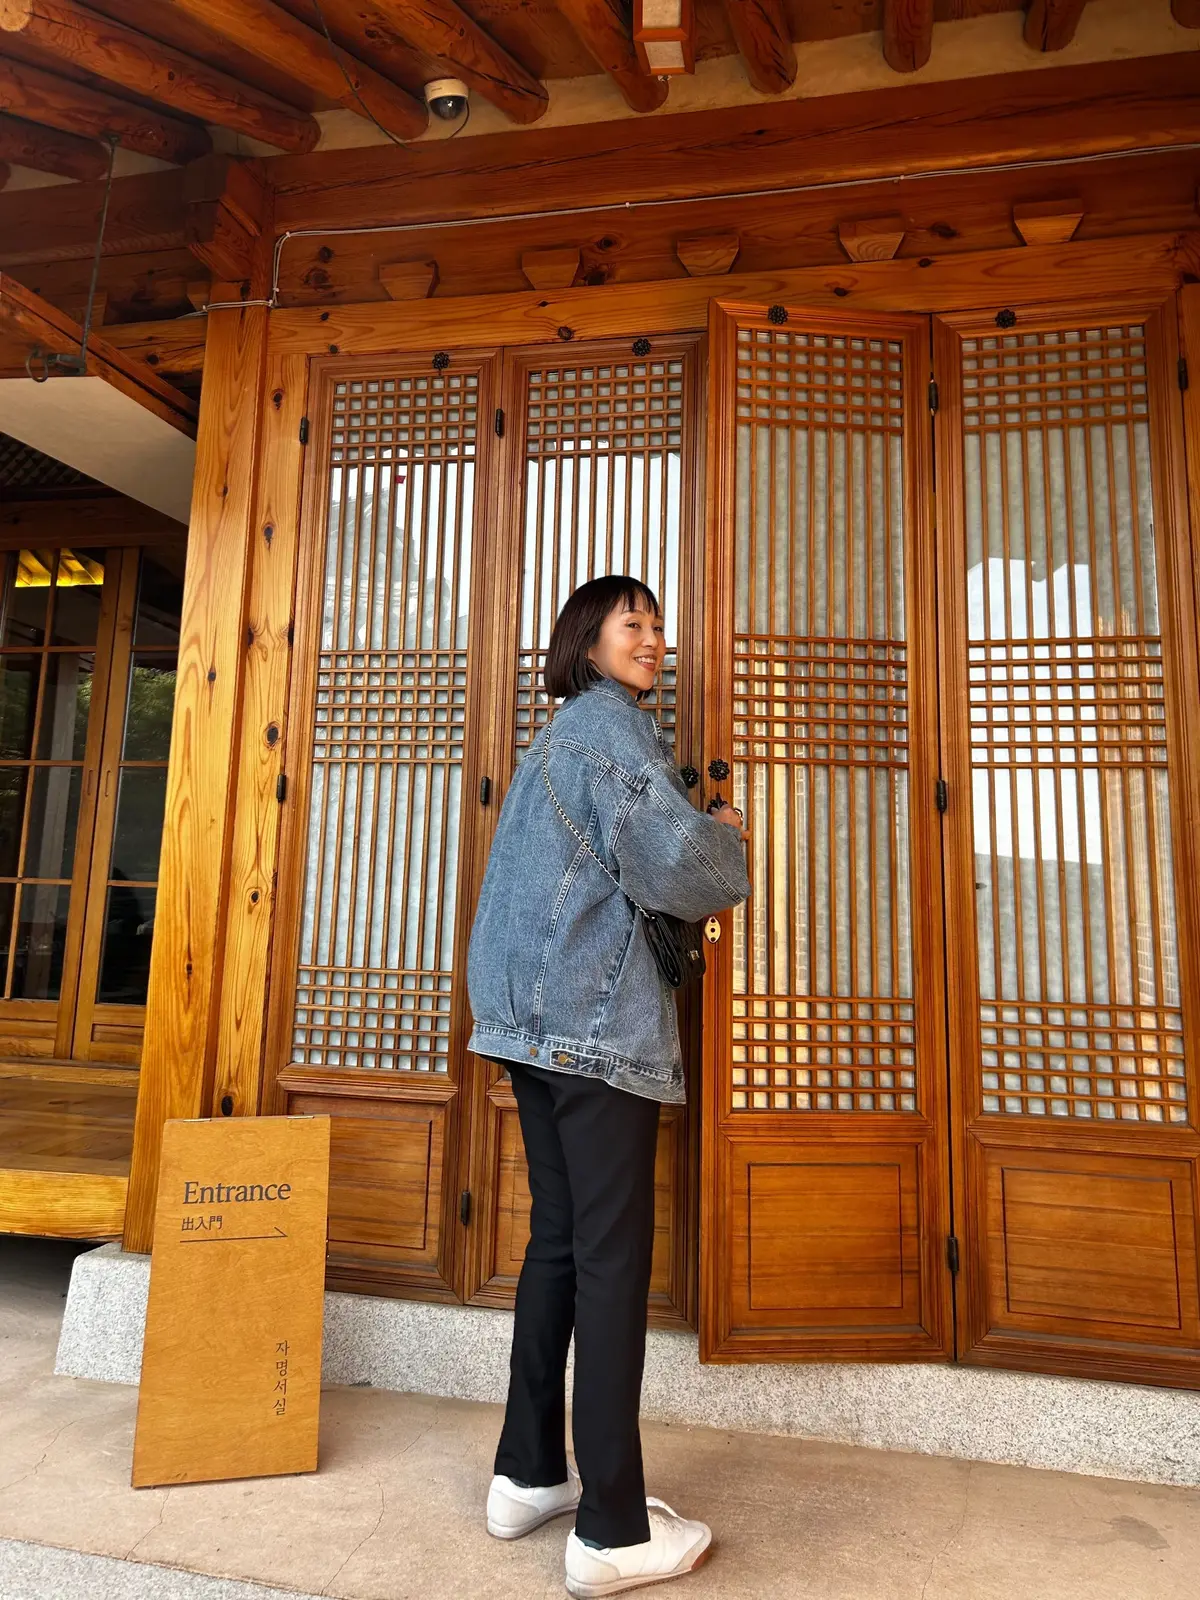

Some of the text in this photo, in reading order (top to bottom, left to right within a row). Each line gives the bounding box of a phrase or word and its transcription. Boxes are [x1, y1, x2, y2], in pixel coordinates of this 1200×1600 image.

[183, 1181, 291, 1204] Entrance
[181, 1215, 223, 1231] 出入門
[272, 1340, 290, 1416] 자명서실
